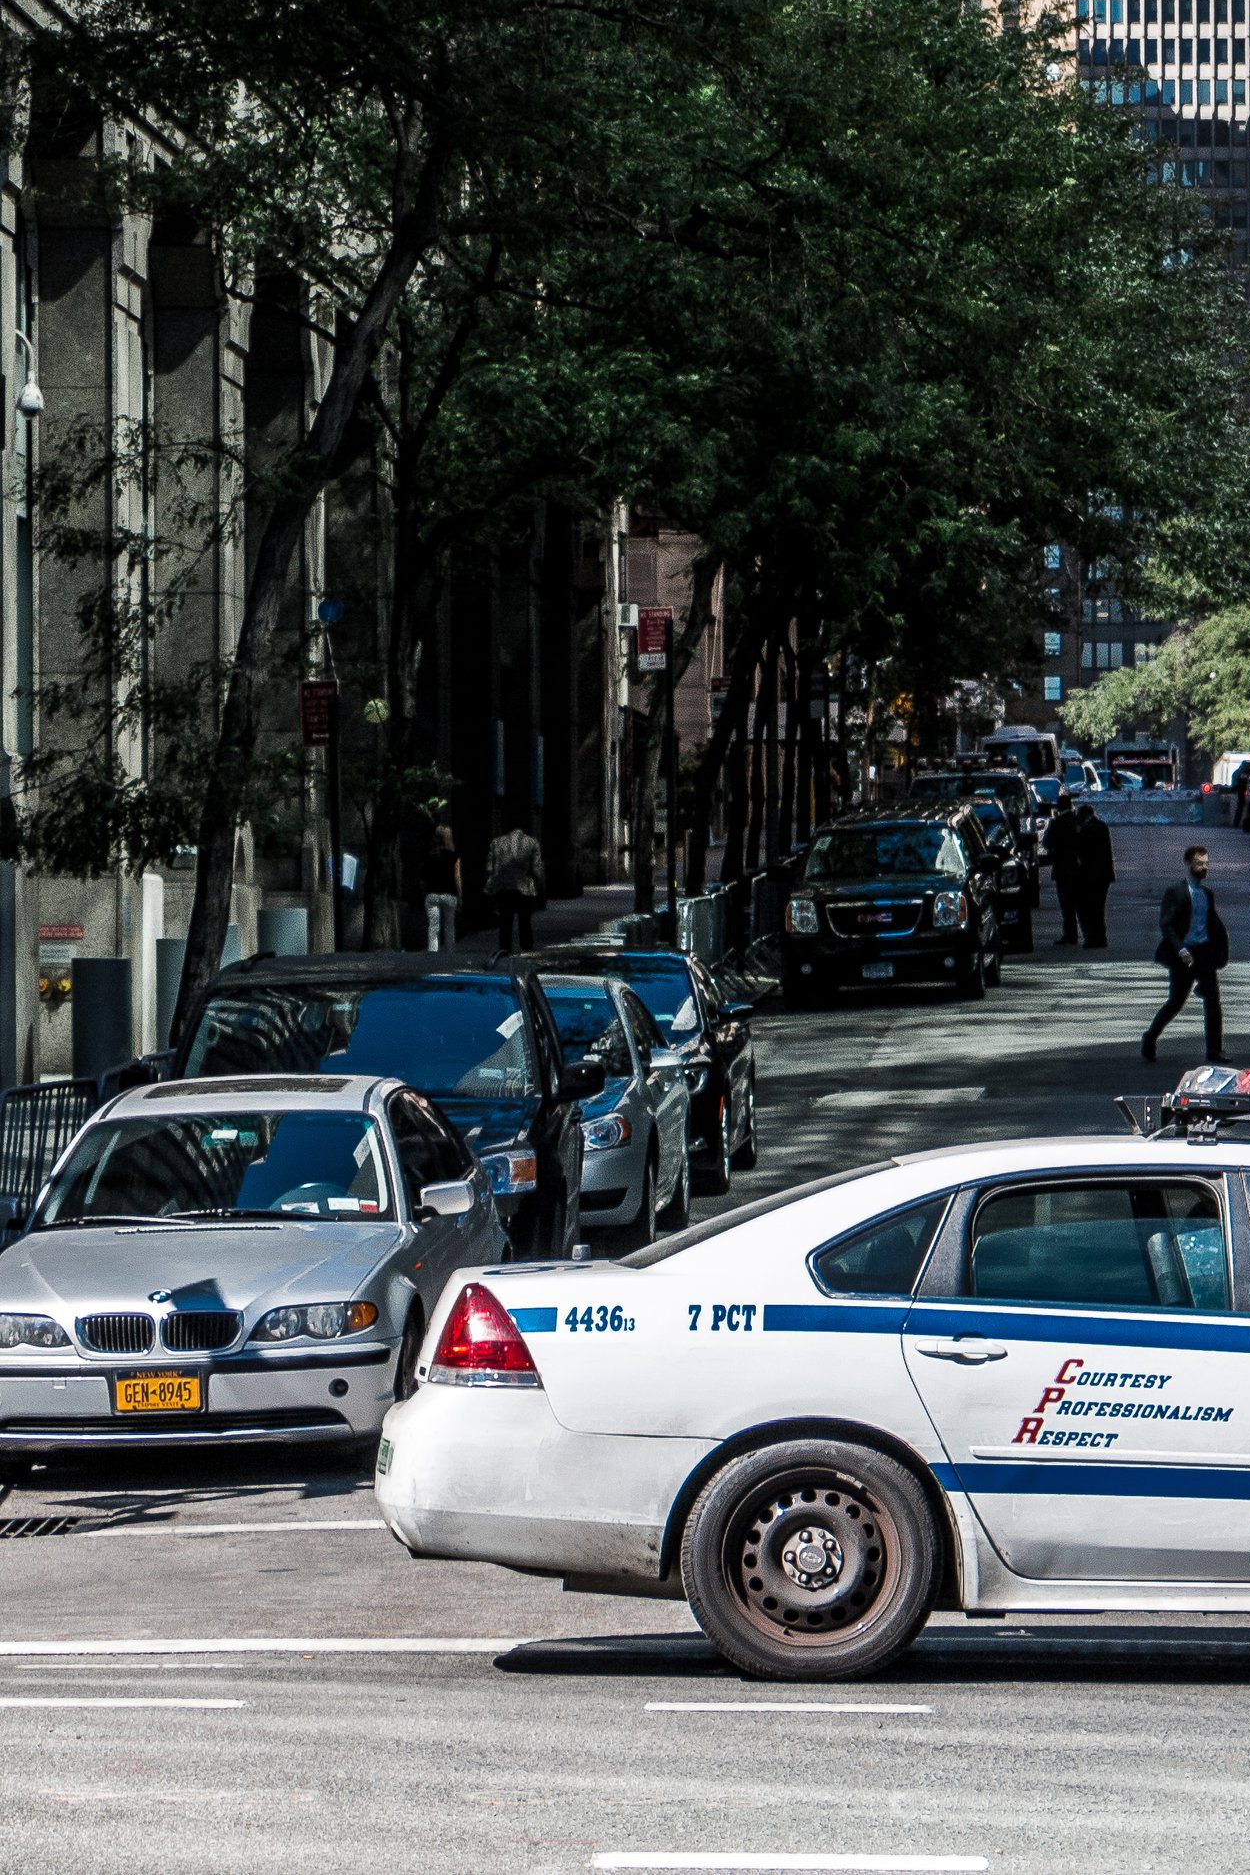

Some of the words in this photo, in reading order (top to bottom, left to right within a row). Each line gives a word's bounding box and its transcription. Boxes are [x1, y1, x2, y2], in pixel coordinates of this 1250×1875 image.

[688, 1304, 702, 1331] 7
[711, 1304, 757, 1331] PCT
[136, 1371, 155, 1379] NEW
[157, 1370, 178, 1378] YORK
[1055, 1358, 1172, 1389] COURTESY
[1033, 1387, 1234, 1422] PROFESSIONALISM
[1012, 1417, 1119, 1449] RESPECT
